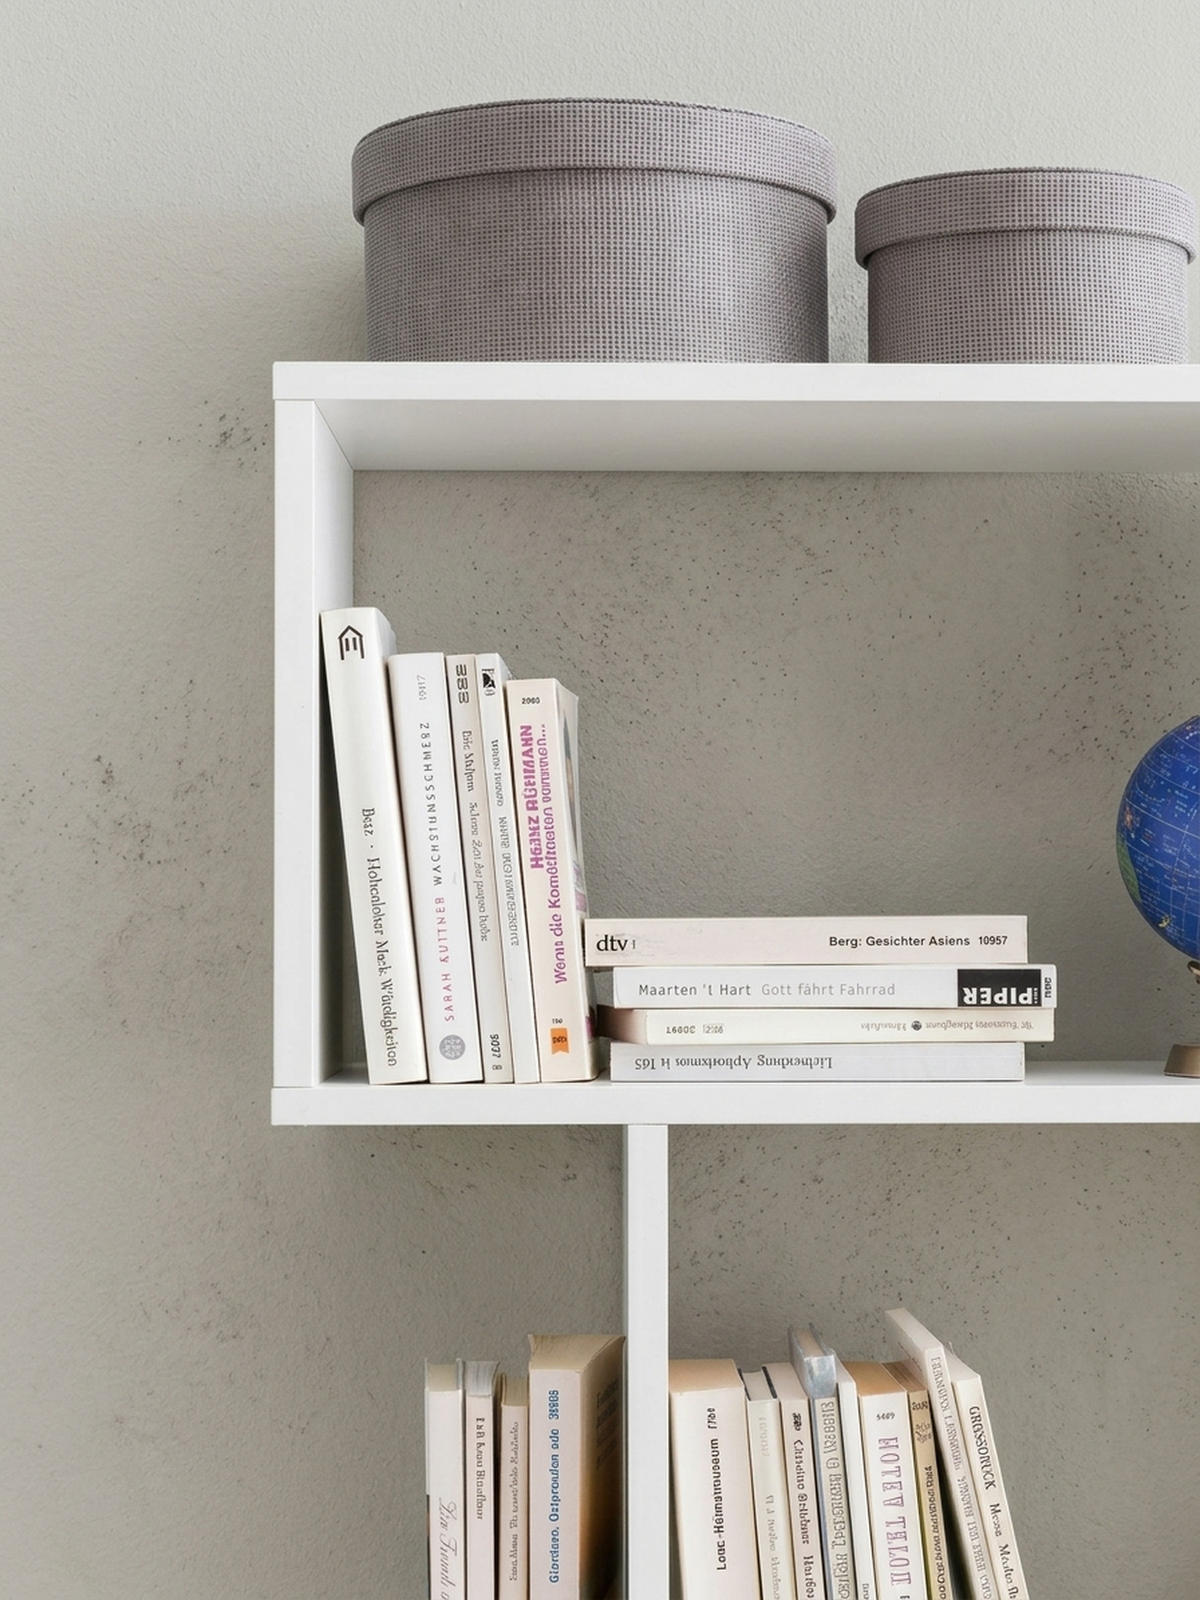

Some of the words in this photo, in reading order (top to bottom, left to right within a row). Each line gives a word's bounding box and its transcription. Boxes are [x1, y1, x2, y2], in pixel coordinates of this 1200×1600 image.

[597, 935, 628, 951] dtv
[830, 937, 861, 948] Berg:
[866, 936, 925, 946] Gesichter
[929, 936, 970, 945] Asiens
[979, 936, 1007, 945] 10957
[639, 985, 696, 996] Maarten
[720, 984, 750, 995] Hart
[762, 984, 792, 995] Gott
[840, 984, 895, 995] Fahrrad
[963, 988, 1032, 1005] PIPER
